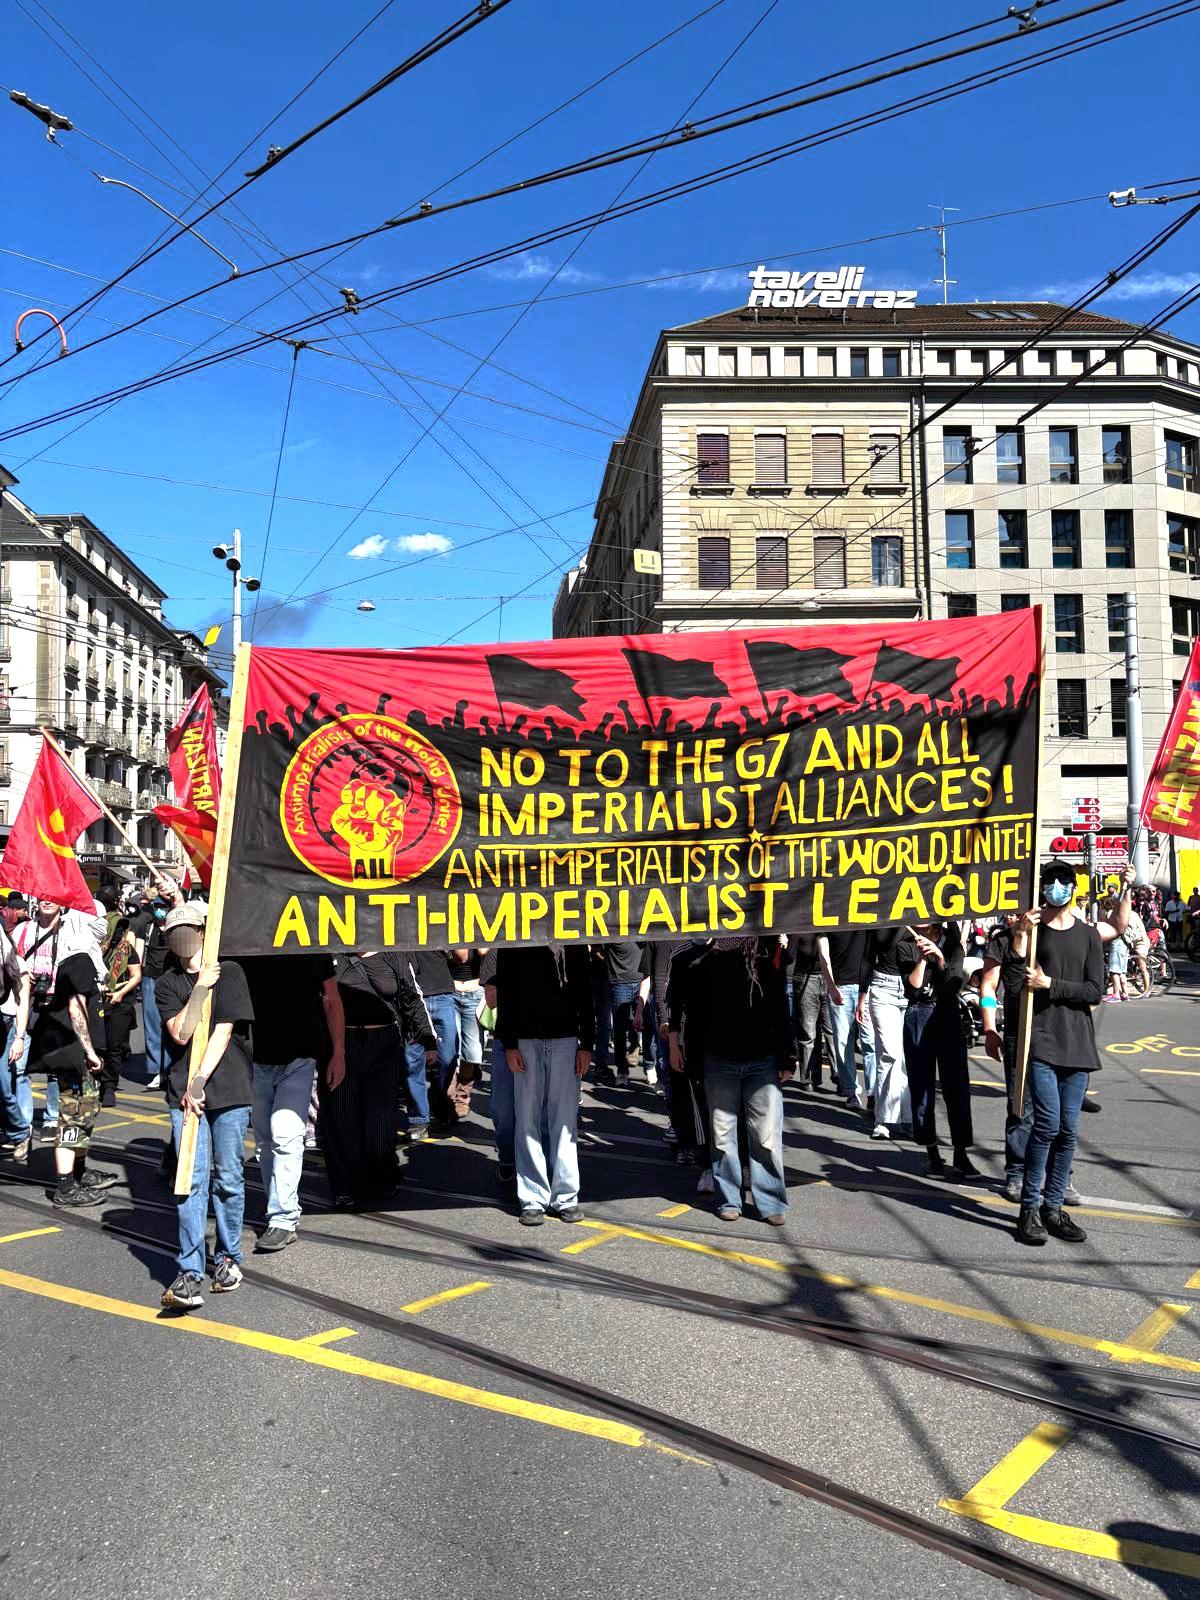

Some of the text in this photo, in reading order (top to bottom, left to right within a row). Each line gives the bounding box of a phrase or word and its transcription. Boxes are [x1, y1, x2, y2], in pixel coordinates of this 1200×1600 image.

[748, 265, 866, 290] tavelli
[748, 290, 918, 309] noverraz
[354, 721, 371, 737] of
[376, 724, 402, 742] the
[481, 717, 980, 788] NO TO THE G7 AND ALL
[478, 783, 761, 838] IMPERIALIST
[354, 858, 394, 880] AIL
[443, 843, 740, 890] ANTI-IMPERIALISTS
[748, 841, 781, 879] OF
[784, 838, 833, 879] THE
[271, 866, 1020, 948] ANTI-IMPERIALIST LEAGUE
